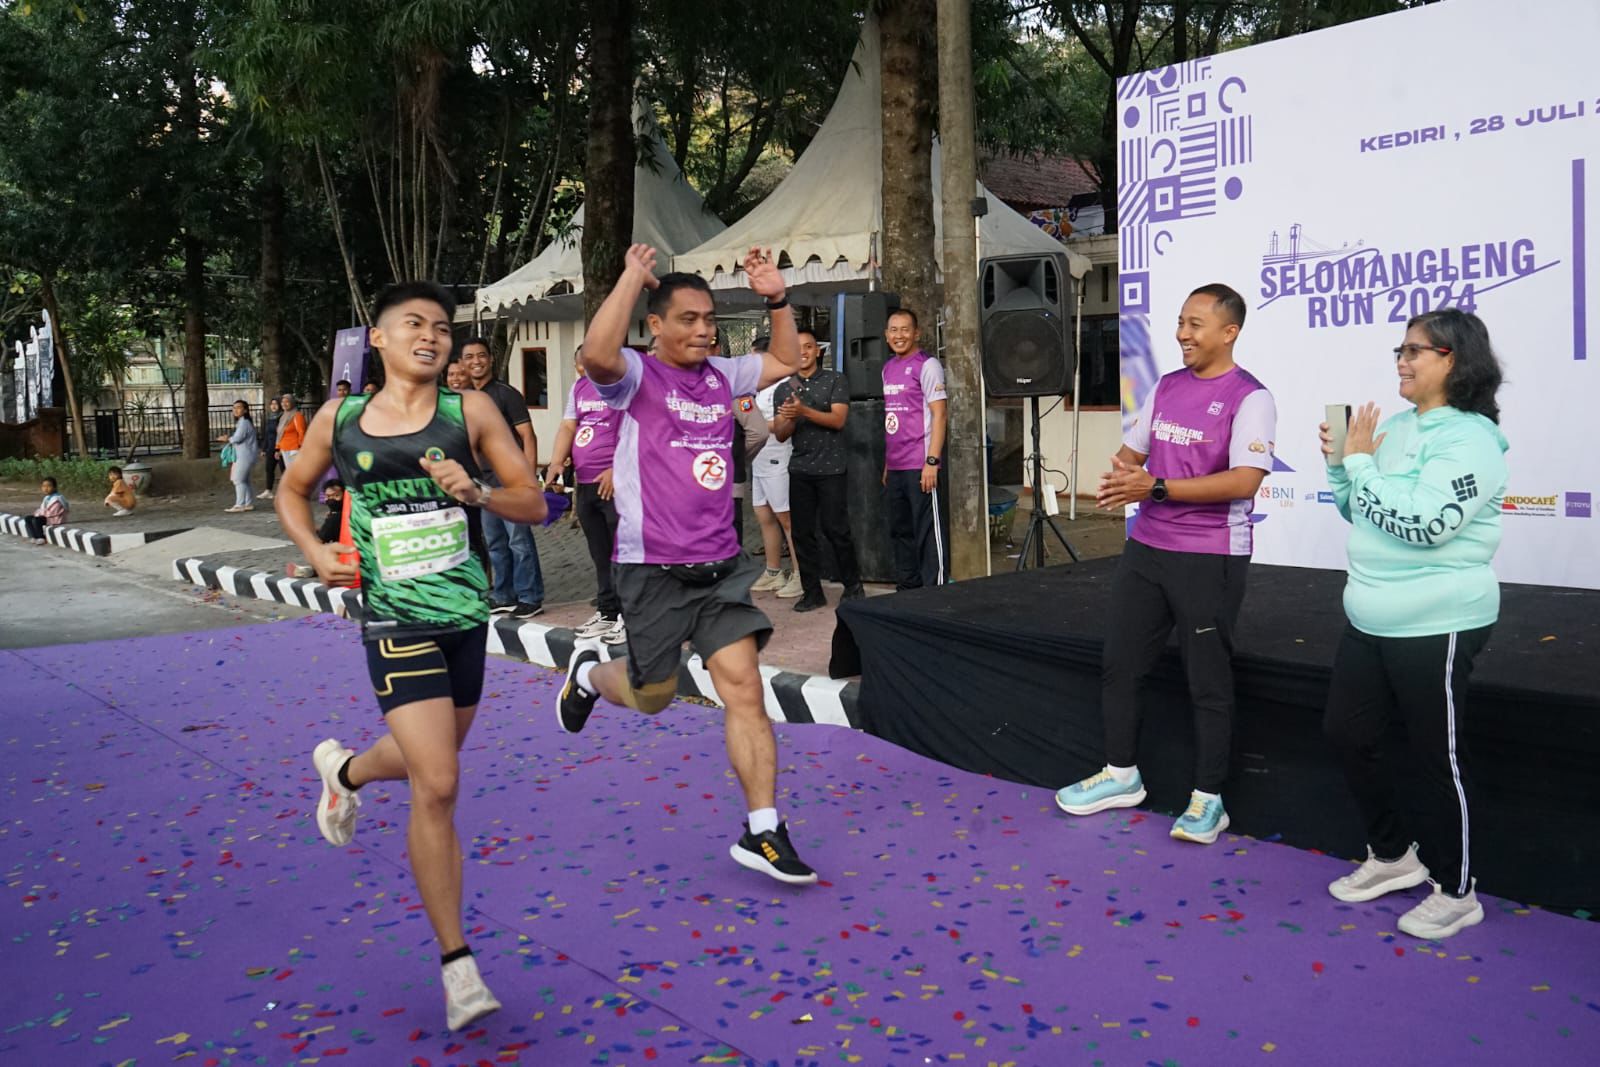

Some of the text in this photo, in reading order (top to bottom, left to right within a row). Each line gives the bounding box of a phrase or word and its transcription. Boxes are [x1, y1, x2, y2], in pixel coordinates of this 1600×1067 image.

[1360, 125, 1446, 153] KEDIRI
[1469, 115, 1505, 135] 28
[1515, 101, 1585, 127] JULI
[1260, 238, 1536, 299] SELOMANGLENG
[1308, 283, 1478, 329] RUN 2024
[1170, 435, 1191, 447] 2024
[1272, 487, 1294, 500] BNI
[1362, 486, 1421, 525] PFG
[1356, 495, 1464, 545] Columbia
[389, 531, 458, 556] 2001
